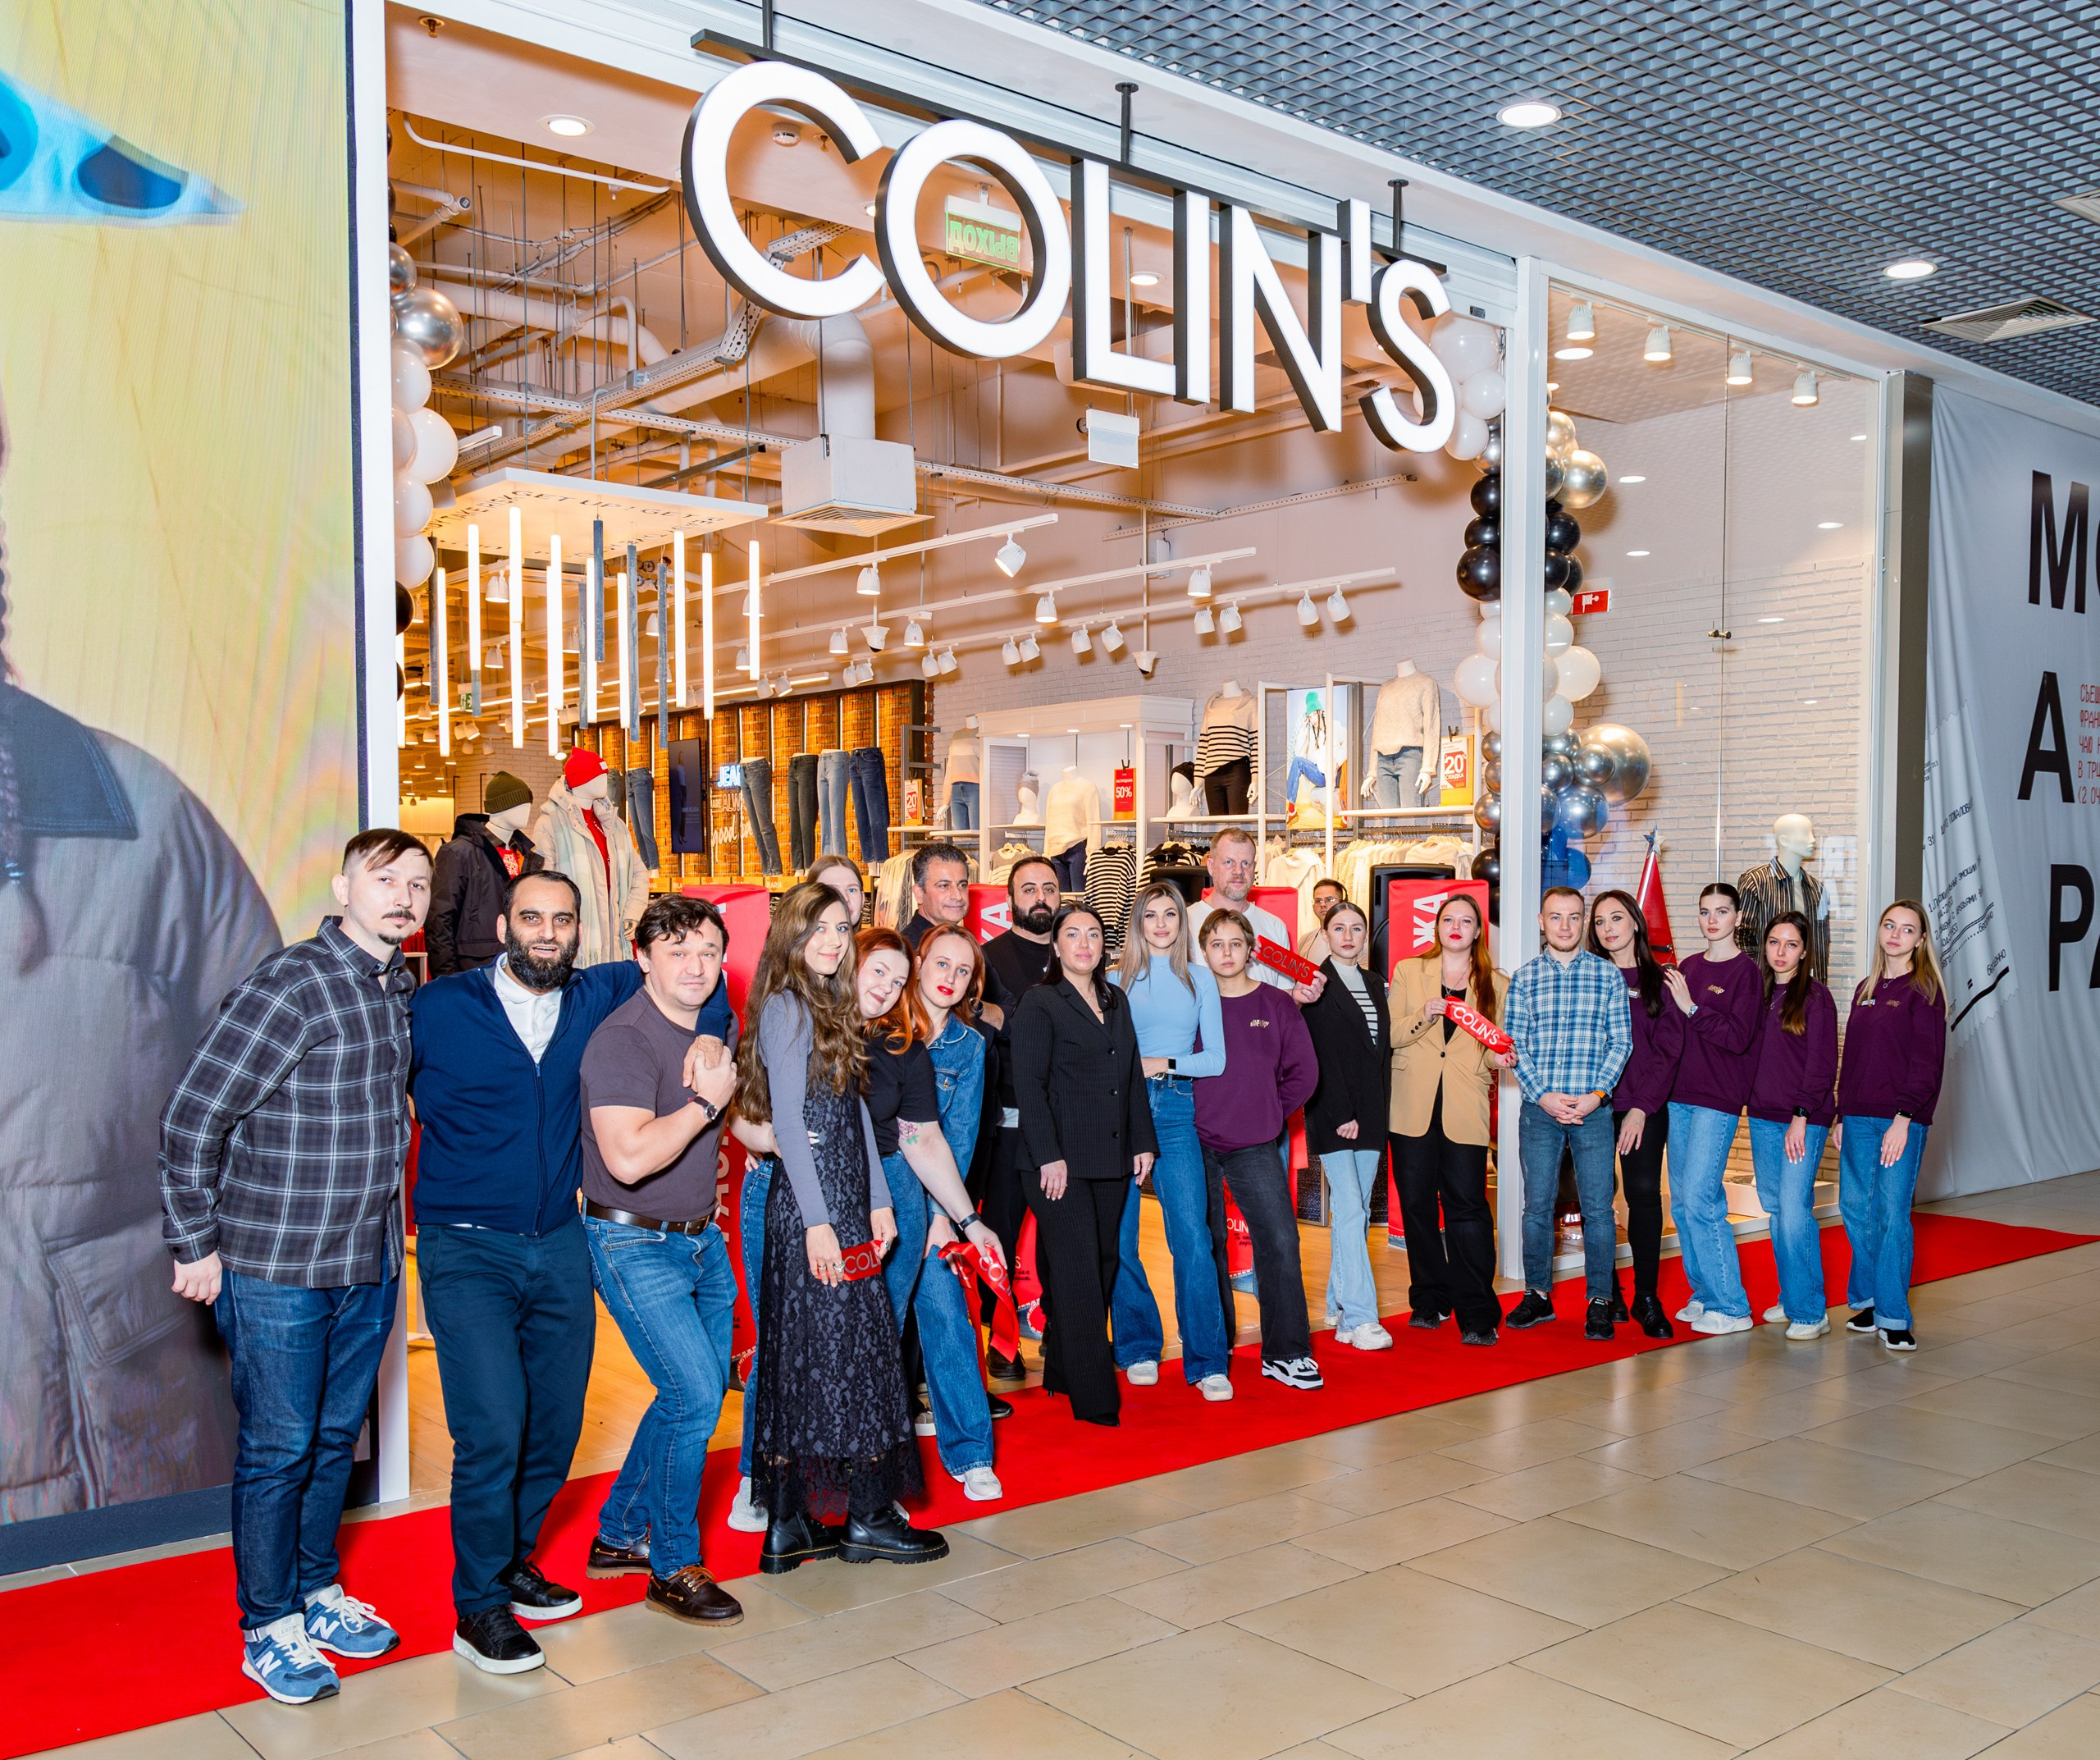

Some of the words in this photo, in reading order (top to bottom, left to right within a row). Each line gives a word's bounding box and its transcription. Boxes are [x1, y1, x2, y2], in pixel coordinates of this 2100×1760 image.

[681, 61, 1455, 453] COLIN'S
[512, 490, 576, 501] GET
[641, 508, 699, 519] GET
[2029, 470, 2100, 614] М
[2079, 710, 2100, 729] ФРАН
[1116, 786, 1132, 798] 50%
[1262, 945, 1310, 978] COLIN'S
[1453, 1006, 1500, 1045] COLIN'S
[308, 1616, 340, 1639] N
[255, 1650, 282, 1678] N
